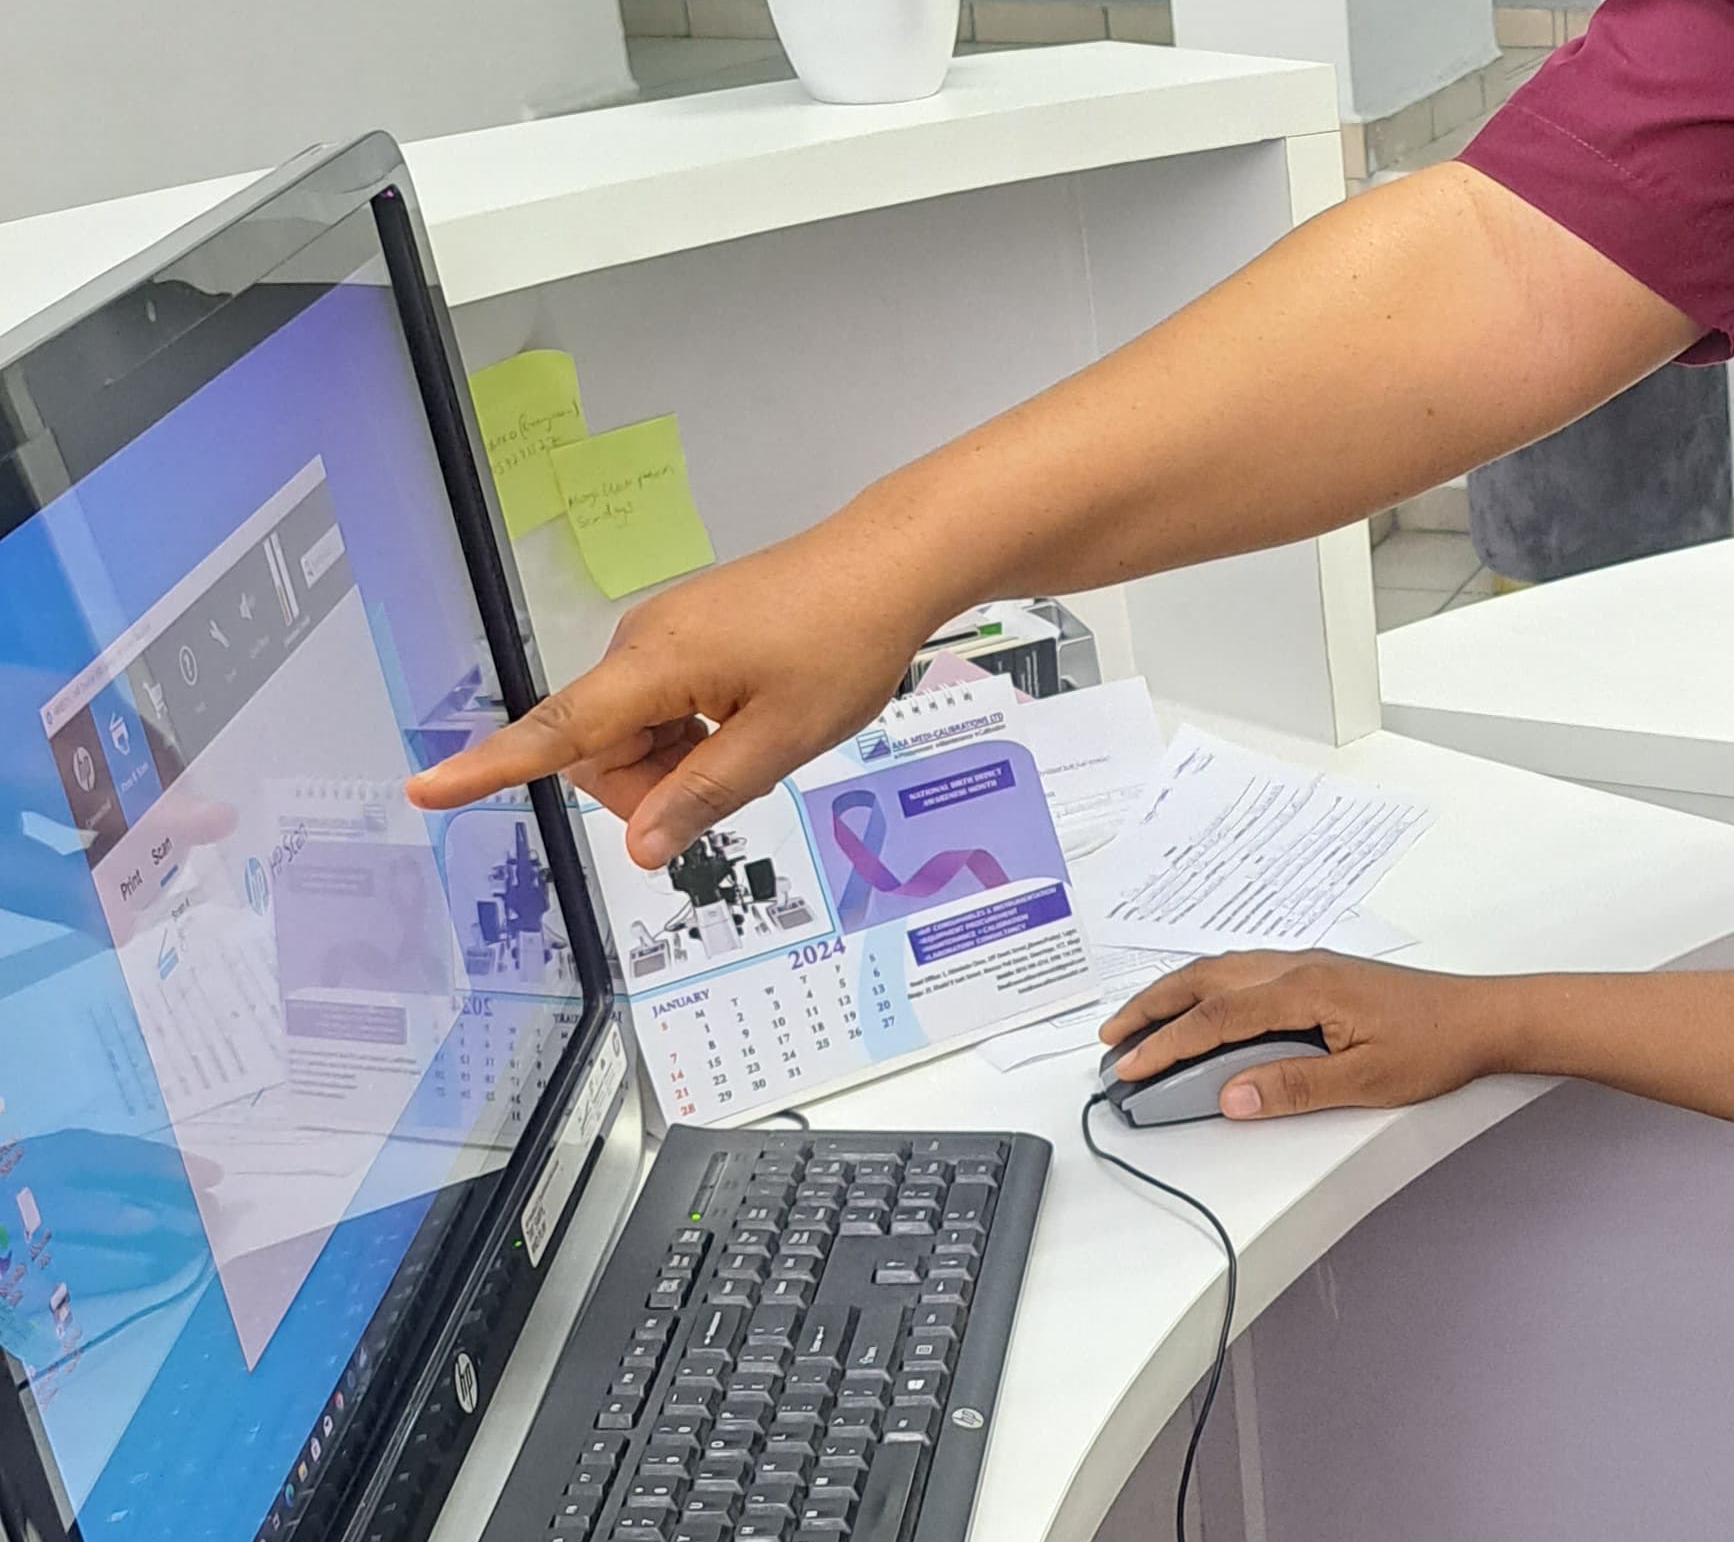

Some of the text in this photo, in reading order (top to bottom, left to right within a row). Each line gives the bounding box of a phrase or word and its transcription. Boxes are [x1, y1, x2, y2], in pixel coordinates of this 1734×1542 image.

[151, 837, 173, 865] Scan
[120, 870, 143, 901] Print
[788, 937, 847, 970] 2024
[652, 989, 710, 1018] JANUARY
[670, 985, 886, 1064] 7 8 9 10 11 12 13
[704, 968, 880, 1033] 1 2 3 4 5 6
[671, 1001, 891, 1082] 14 15 16 17 18 19 20
[675, 1016, 896, 1099] 21 22 23 24 25 26 27
[680, 1067, 801, 1116] 28 29 30 31
[455, 1353, 478, 1414] hp
[740, 1526, 755, 1534] H
